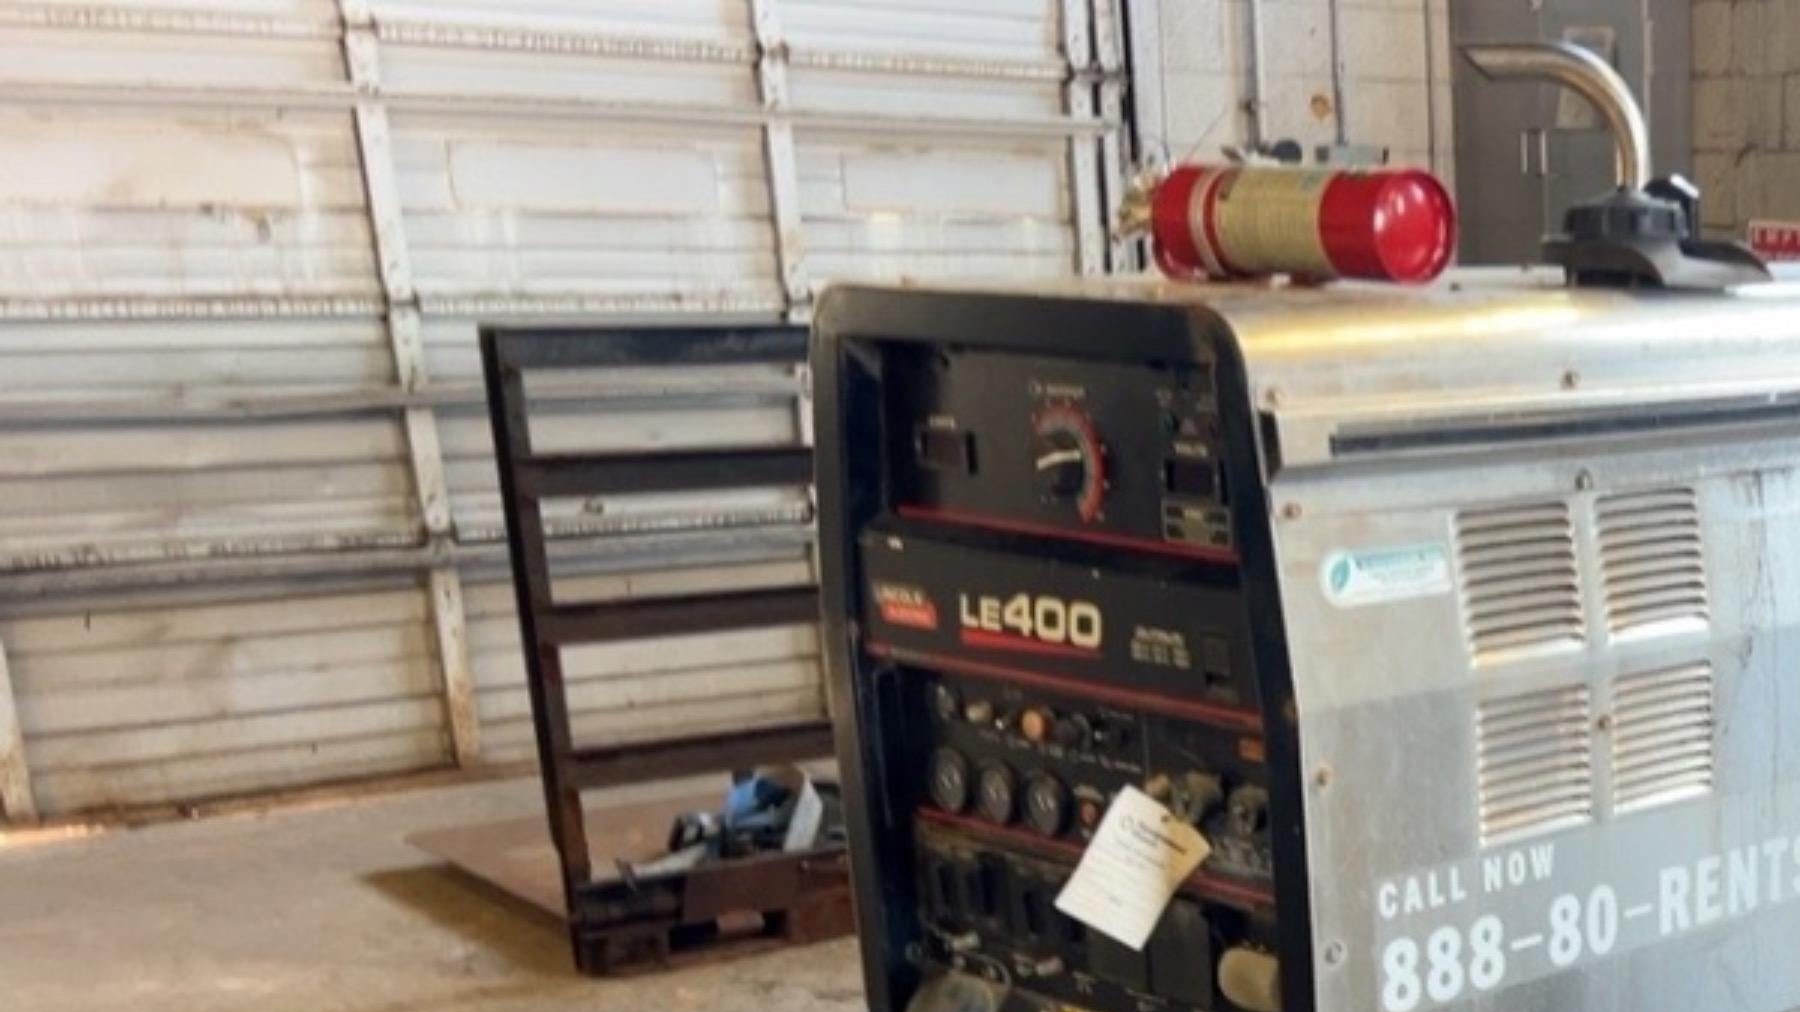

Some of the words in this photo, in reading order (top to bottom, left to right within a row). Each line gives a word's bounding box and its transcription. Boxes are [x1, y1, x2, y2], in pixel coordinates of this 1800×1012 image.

[959, 592, 1102, 649] LE400
[1378, 866, 1467, 919] CALL
[1483, 843, 1555, 894] NOW
